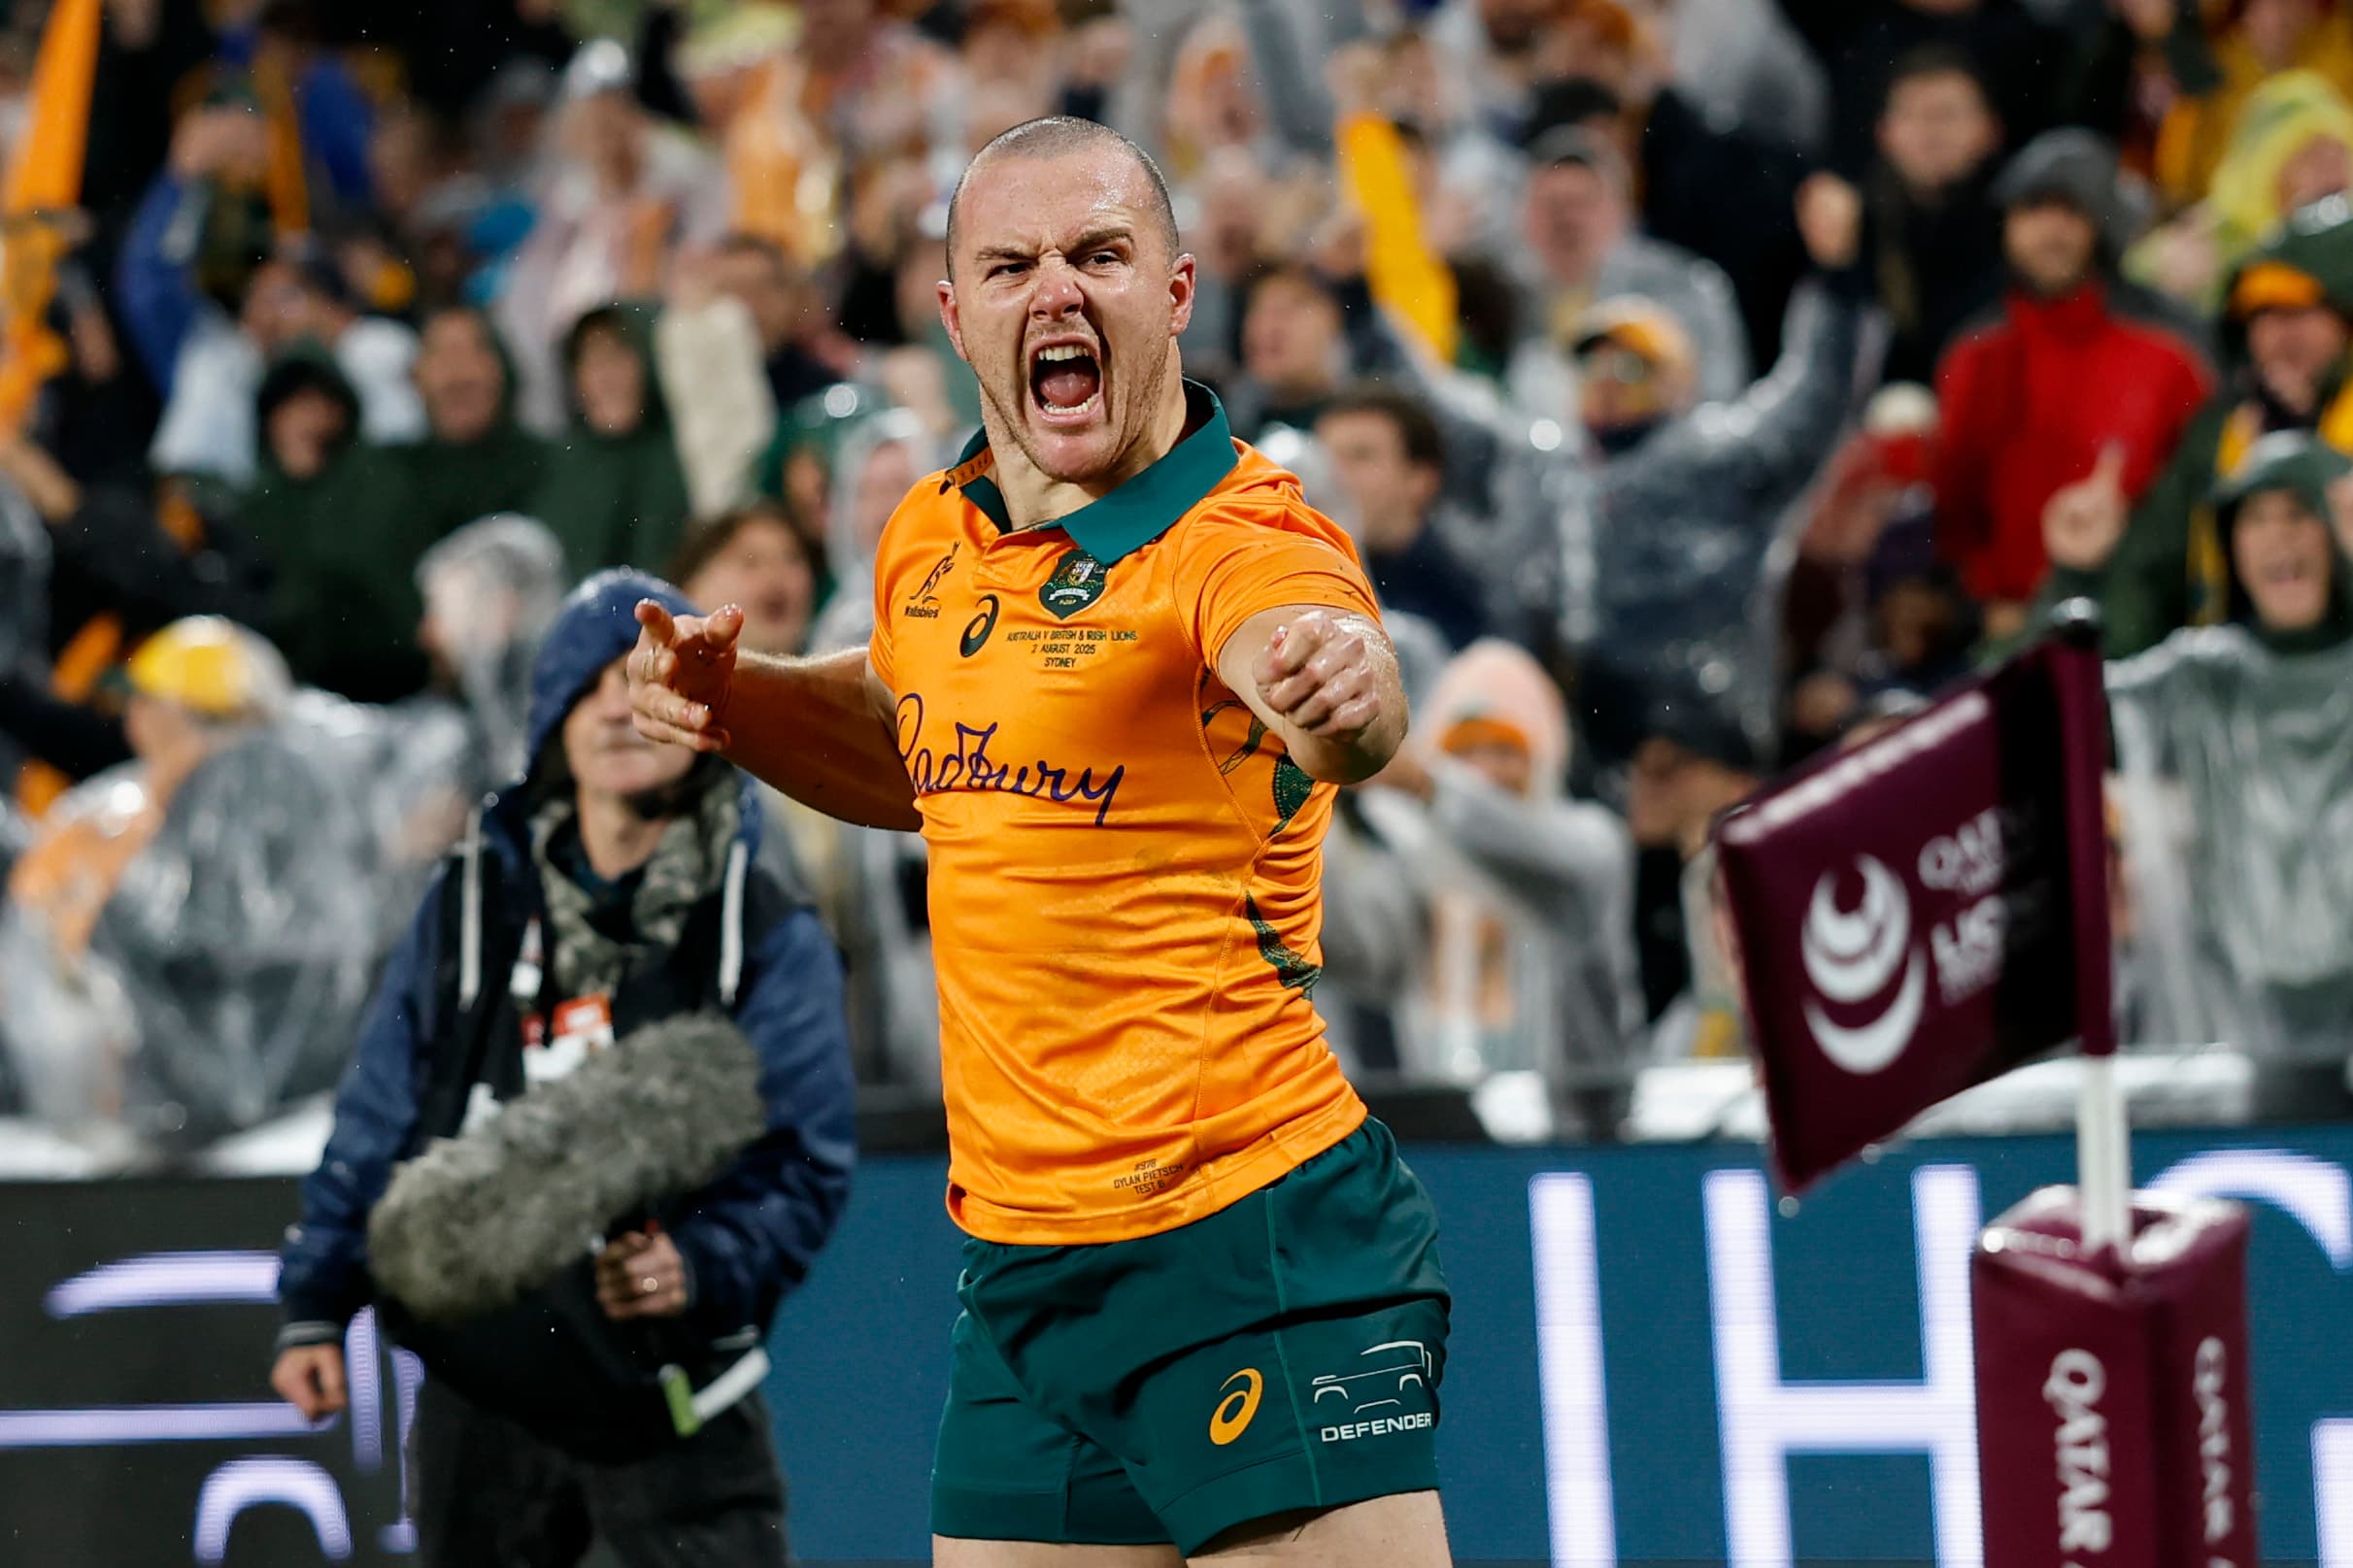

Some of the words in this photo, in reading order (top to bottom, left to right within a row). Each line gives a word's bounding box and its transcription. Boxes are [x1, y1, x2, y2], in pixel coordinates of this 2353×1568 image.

[1006, 630, 1041, 641] AUSTRALIA
[1050, 630, 1077, 641] BRITISH
[1078, 630, 1084, 641] &
[1086, 630, 1107, 641] IRISH
[1110, 630, 1138, 641] LIONS
[1031, 644, 1037, 654] 2
[1040, 644, 1069, 654] AUGUST
[1073, 644, 1096, 654] 2025
[1044, 656, 1077, 668] SYDNEY
[1113, 1173, 1141, 1189] DYLAN
[1143, 1164, 1184, 1182] PIETSCH
[1134, 1182, 1156, 1194] TEST
[1321, 1413, 1432, 1442] DEFENDER
[2041, 1347, 2114, 1553] QATAR
